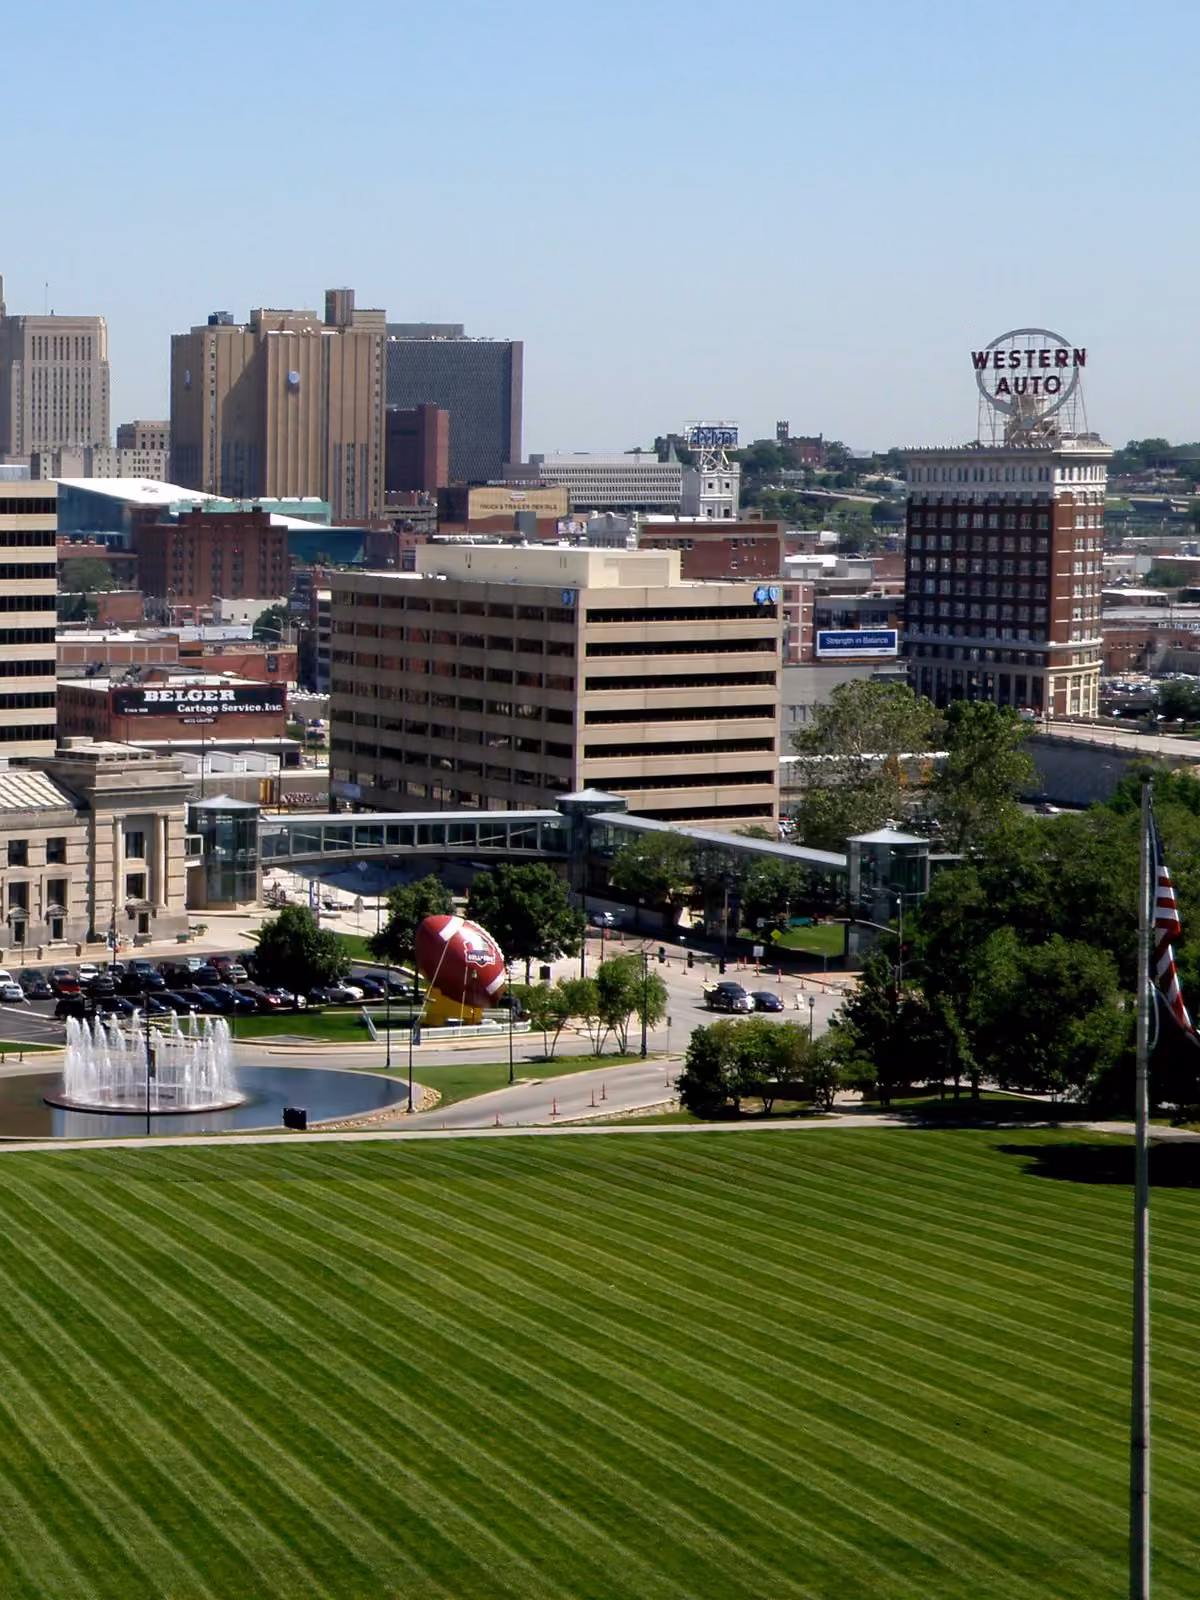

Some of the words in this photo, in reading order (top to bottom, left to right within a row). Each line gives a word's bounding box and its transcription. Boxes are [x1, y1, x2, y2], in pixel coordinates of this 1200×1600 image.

[971, 348, 1086, 370] WESTERN
[995, 375, 1061, 395] AUTO
[143, 689, 236, 702] BELGER
[177, 703, 219, 714] Cartage
